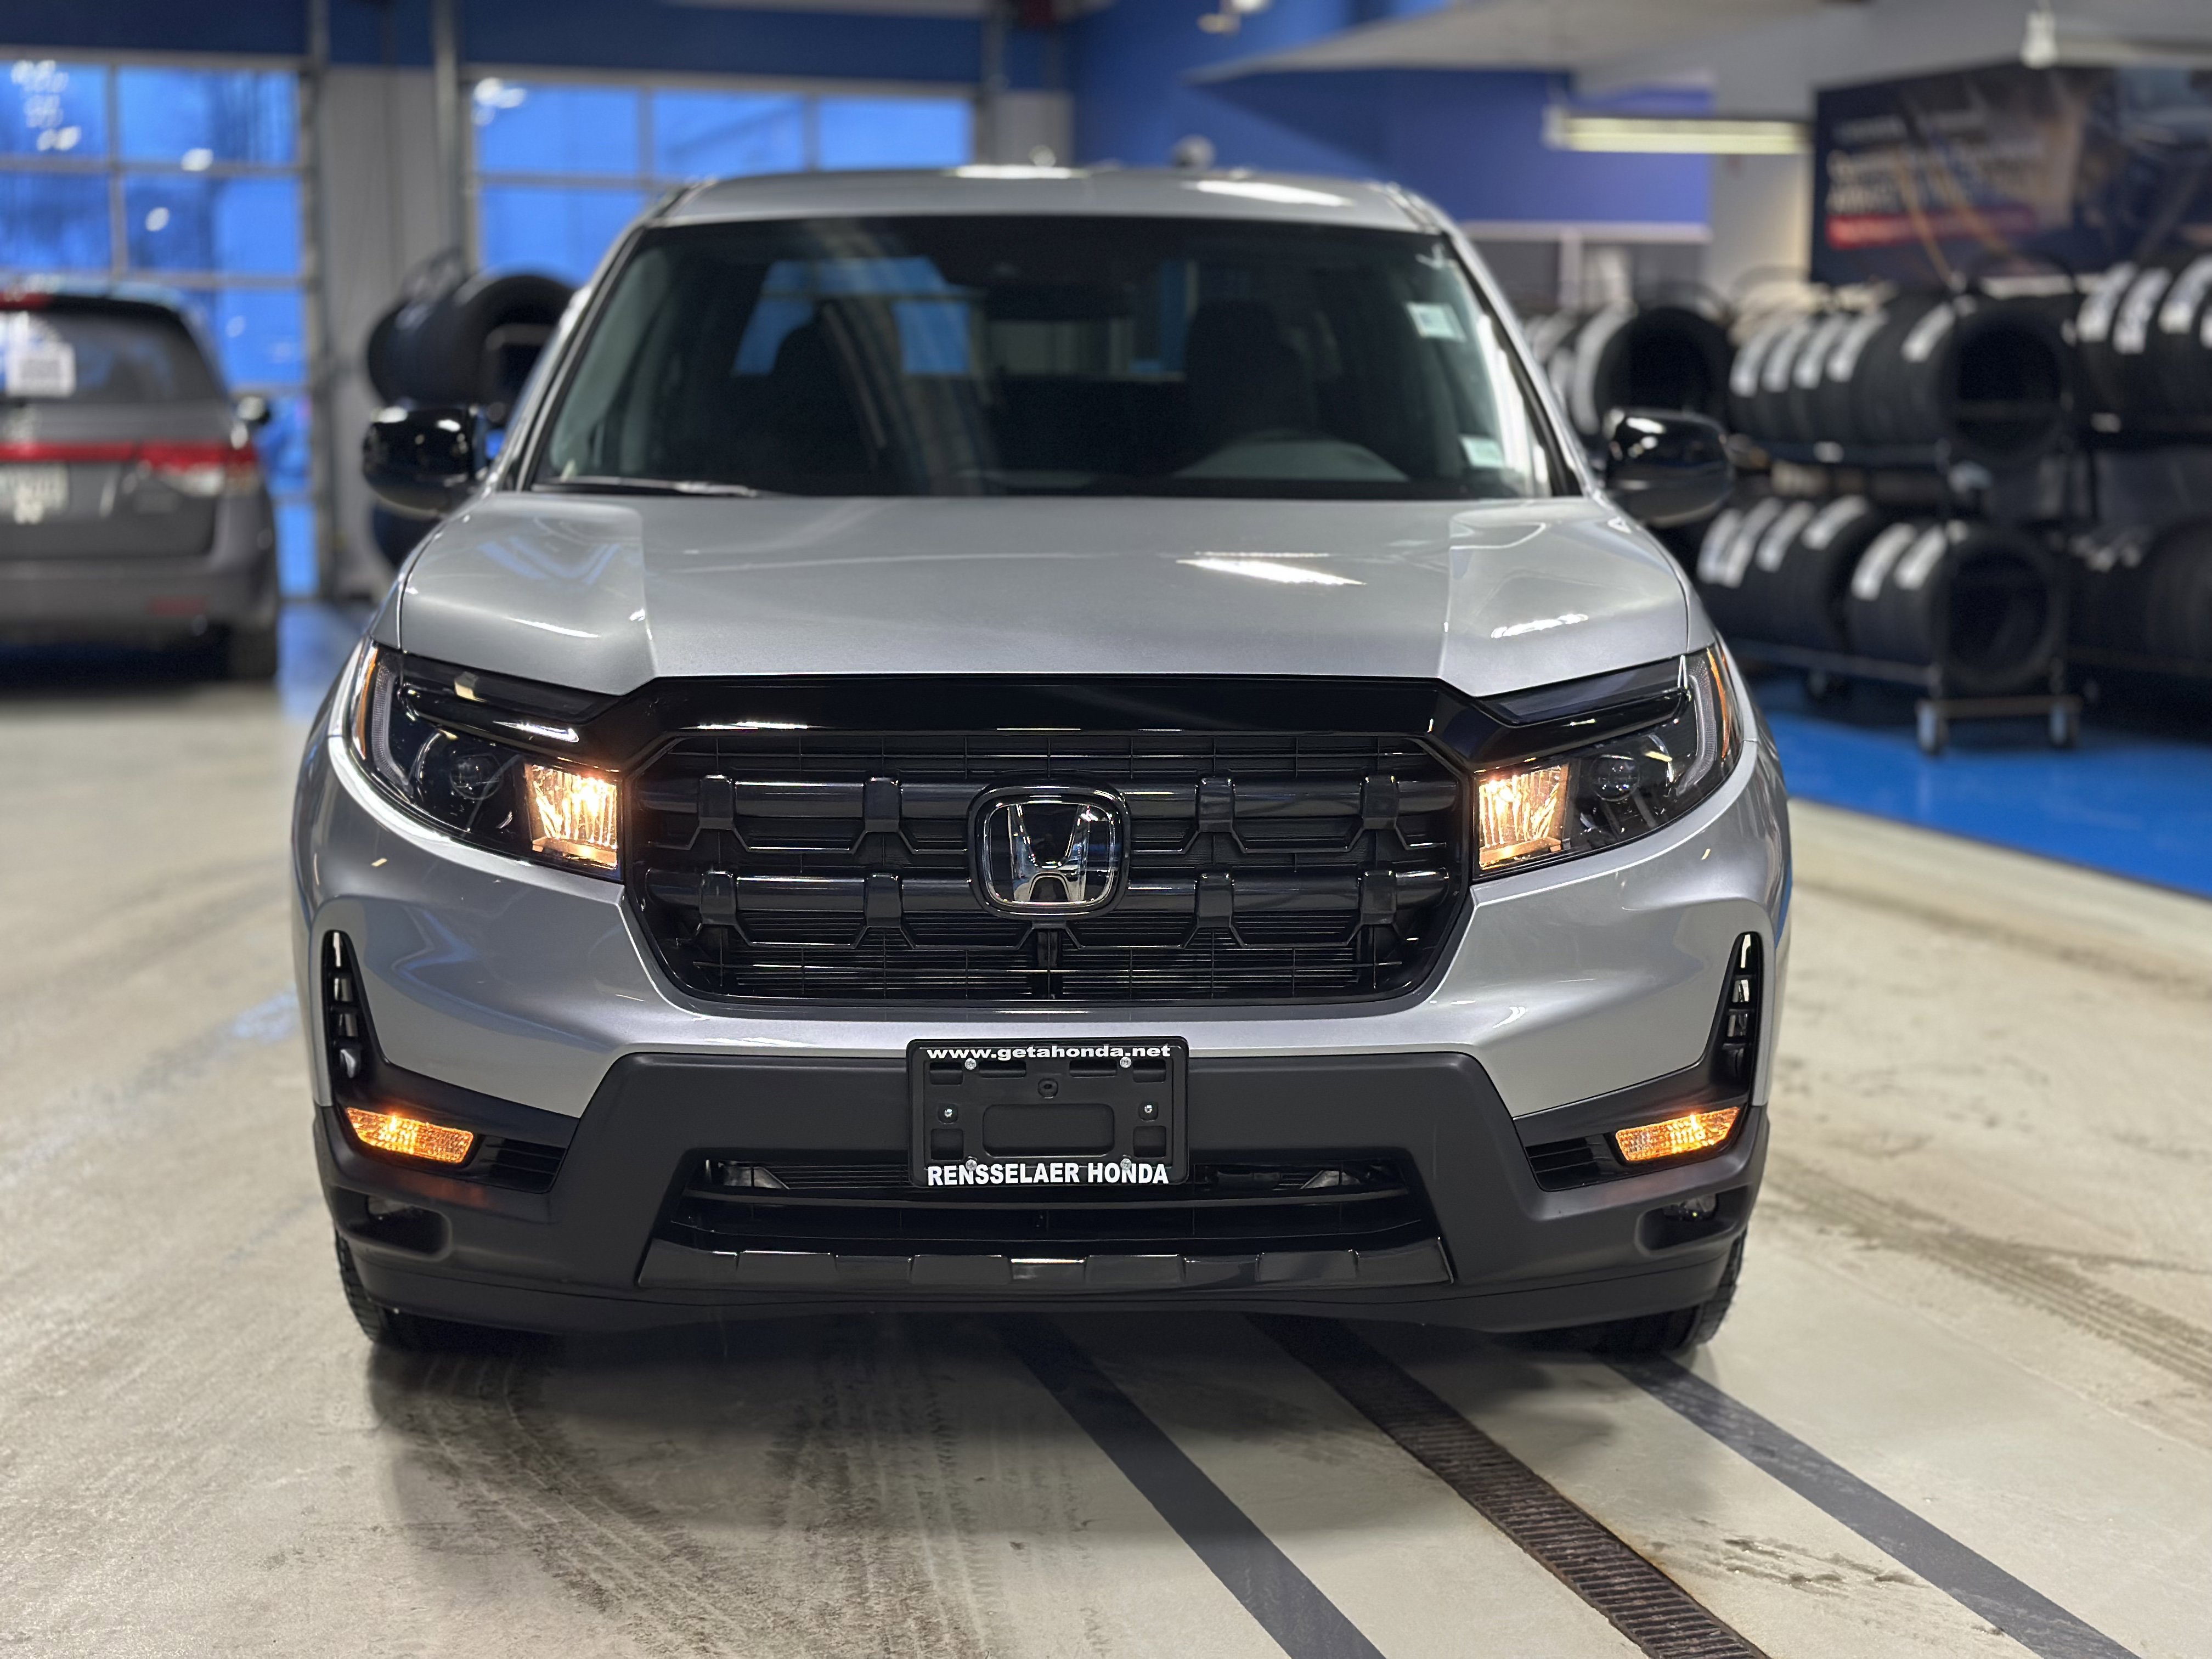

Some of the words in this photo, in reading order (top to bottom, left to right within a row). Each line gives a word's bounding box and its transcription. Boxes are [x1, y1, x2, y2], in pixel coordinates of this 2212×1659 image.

[927, 1045, 1171, 1060] www.getahonda.net
[928, 1163, 1080, 1186] RENSSELAER
[1087, 1163, 1169, 1184] HONDA
